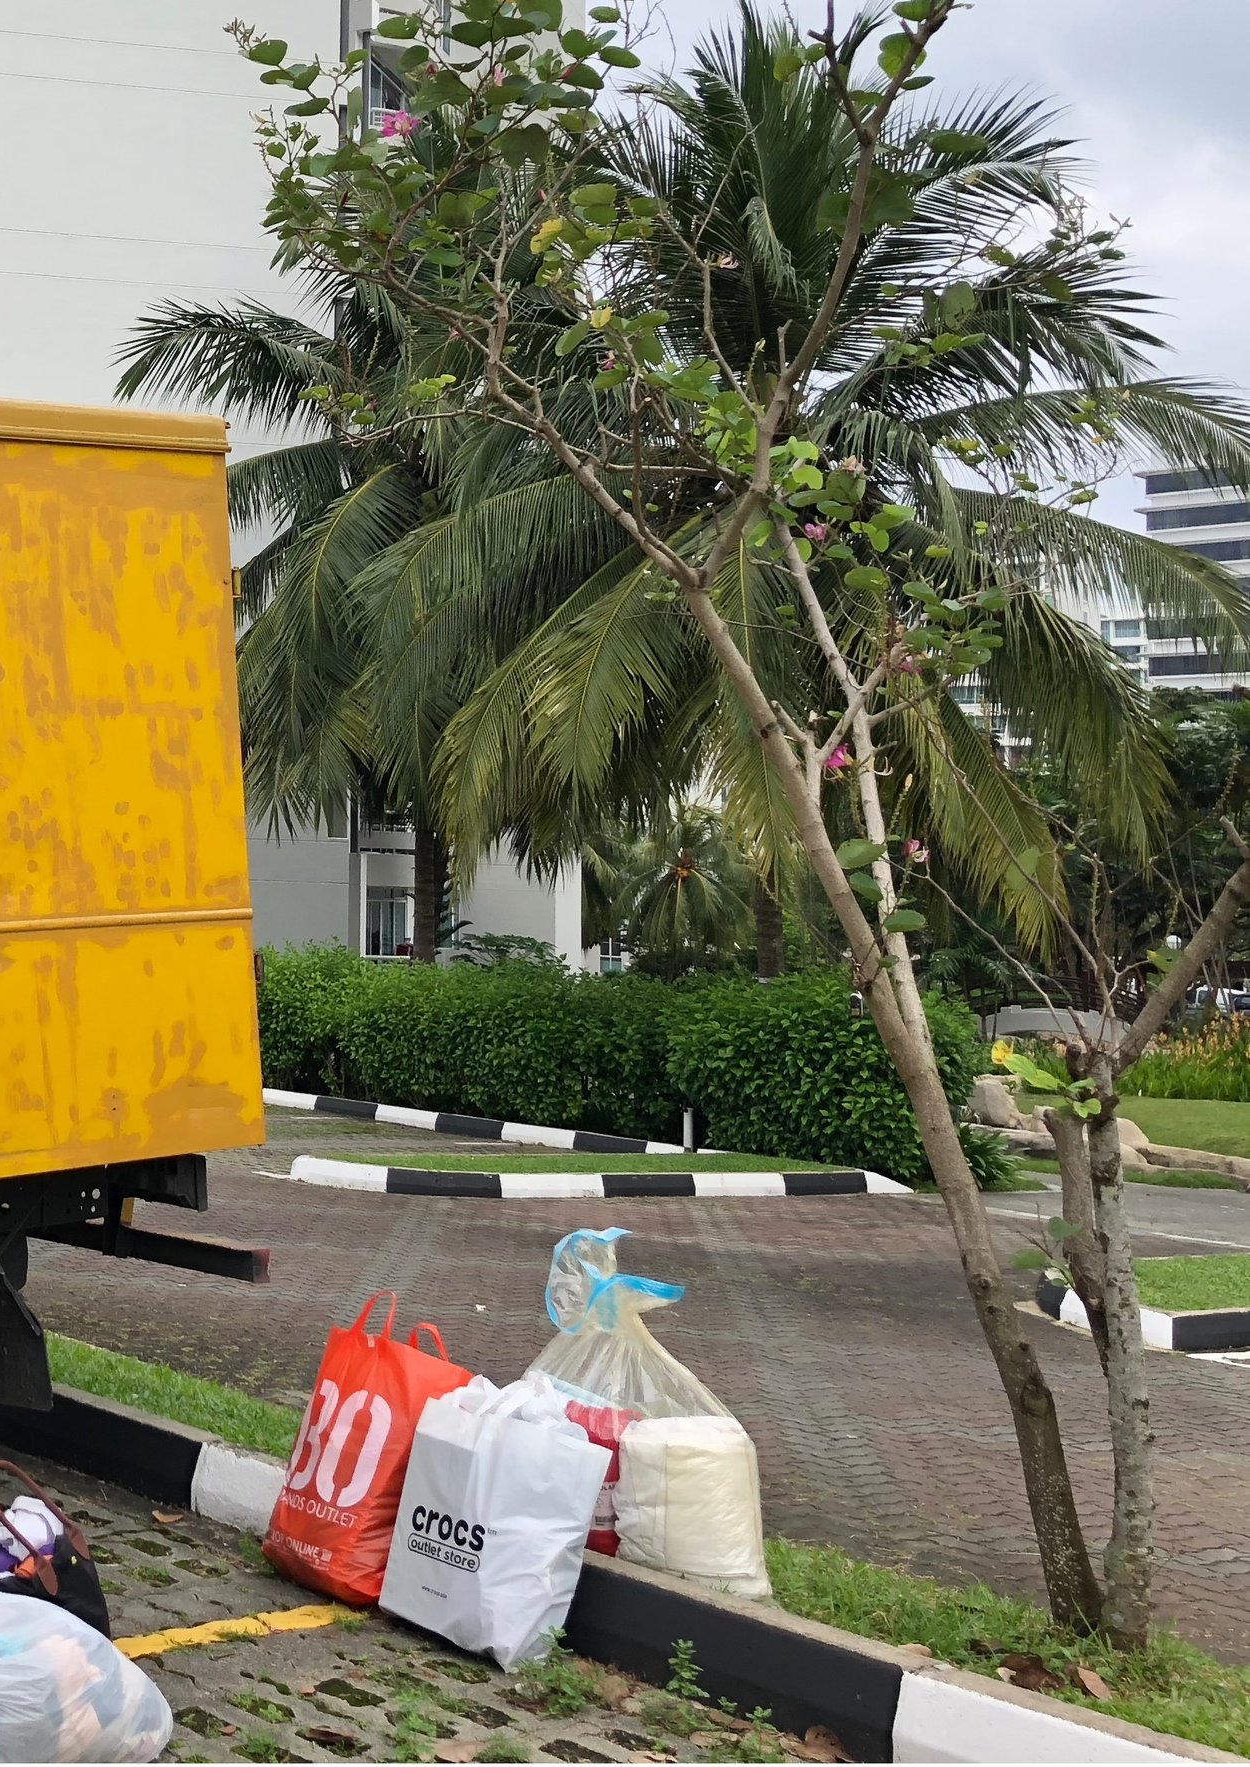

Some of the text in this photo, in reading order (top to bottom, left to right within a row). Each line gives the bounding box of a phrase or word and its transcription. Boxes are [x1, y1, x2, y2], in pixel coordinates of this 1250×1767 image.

[306, 1499, 359, 1528] OUTLET
[411, 1505, 486, 1552] crocs
[286, 1536, 320, 1559] ONLINE
[410, 1538, 476, 1569] outlet store
